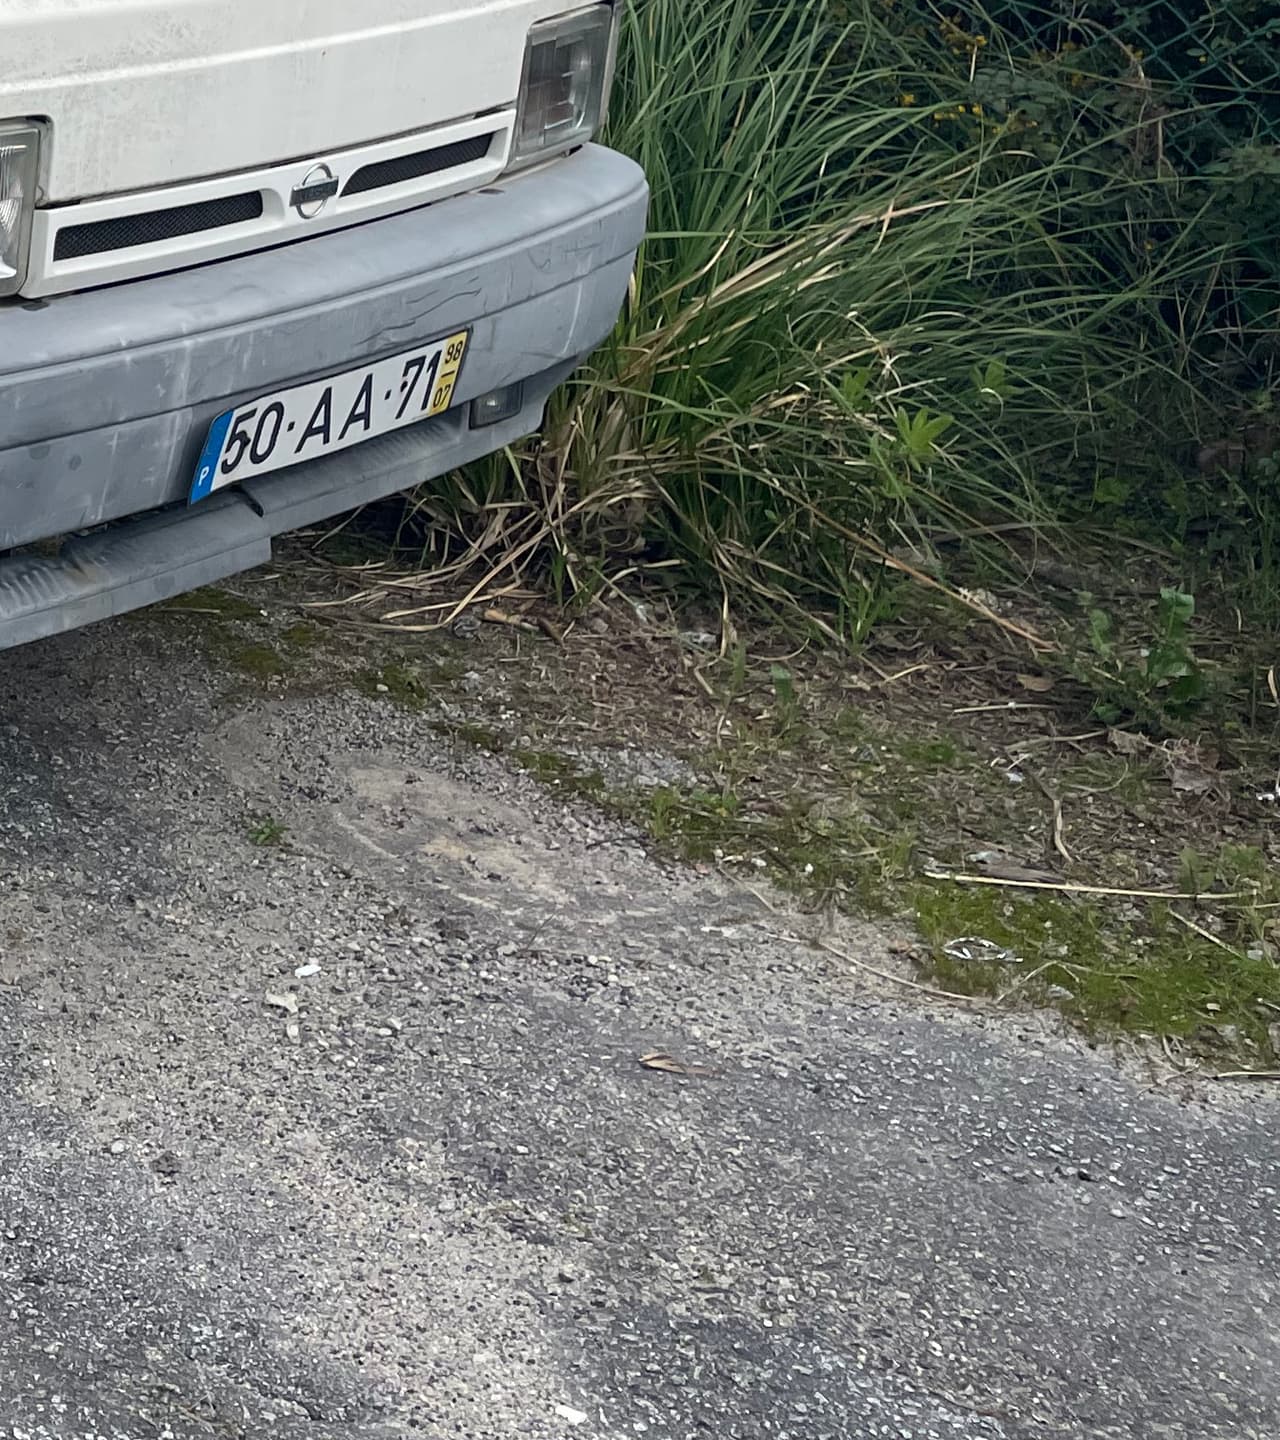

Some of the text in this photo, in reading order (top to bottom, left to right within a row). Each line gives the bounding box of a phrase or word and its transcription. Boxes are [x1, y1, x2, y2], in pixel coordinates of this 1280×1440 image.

[444, 340, 463, 364] 98
[432, 383, 451, 408] 07
[197, 465, 210, 486] P
